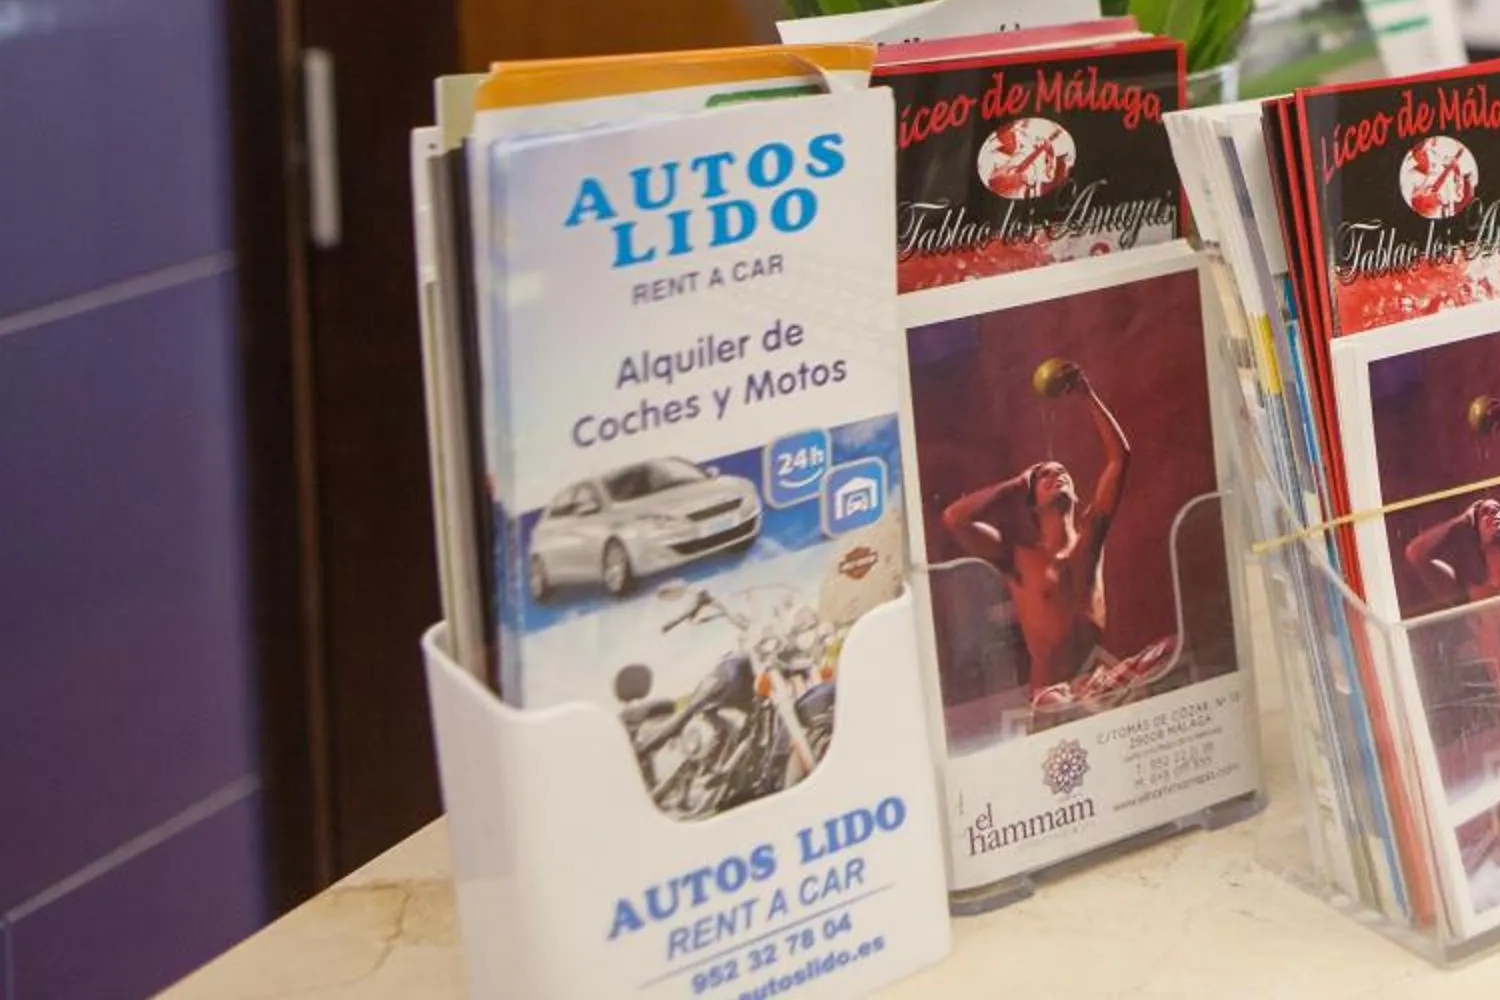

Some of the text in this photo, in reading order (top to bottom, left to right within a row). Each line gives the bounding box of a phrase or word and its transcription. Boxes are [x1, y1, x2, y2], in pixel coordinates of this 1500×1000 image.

[982, 71, 1031, 120] de
[1035, 65, 1162, 131] Málaga
[1398, 90, 1435, 138] de
[564, 132, 846, 228] AUTOS
[611, 186, 818, 269] LIDO
[632, 254, 785, 305] RENT A CAR
[615, 318, 804, 389] Alquiler de
[571, 356, 848, 448] Coches y Motos
[968, 798, 1095, 856] hammam
[975, 802, 993, 831] el
[606, 796, 907, 941] AUTOS LIDO
[666, 857, 866, 961] RENT A CAR
[691, 912, 853, 995] 952 32 78 04
